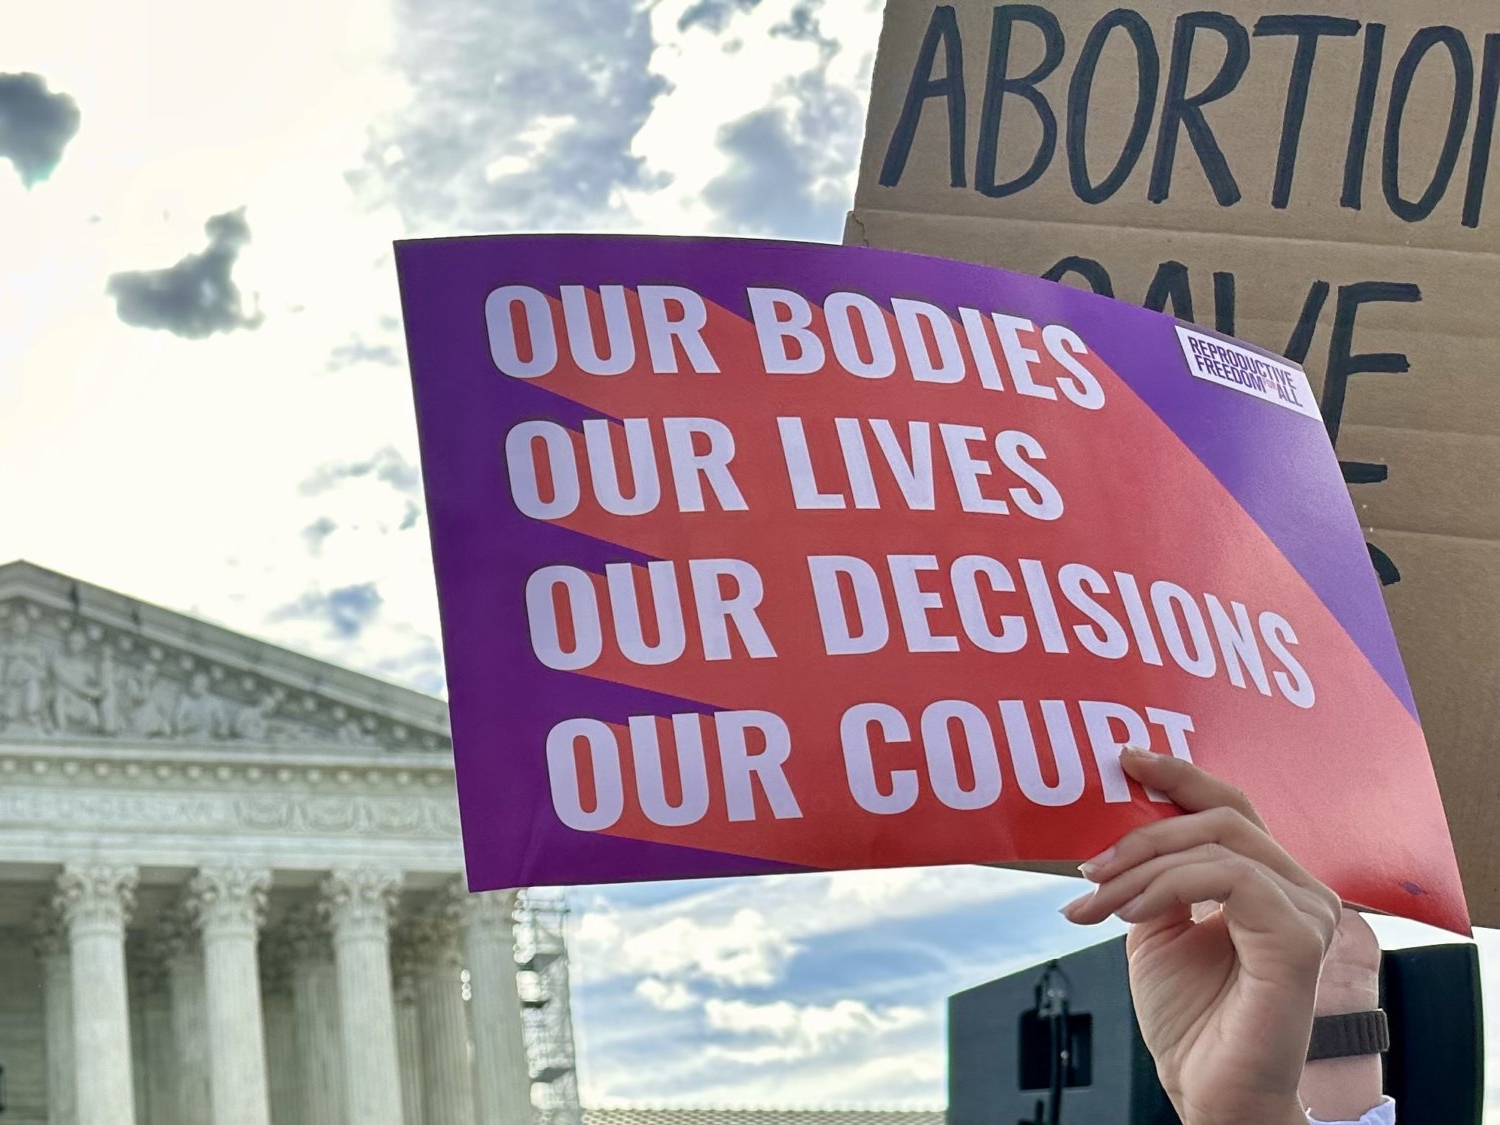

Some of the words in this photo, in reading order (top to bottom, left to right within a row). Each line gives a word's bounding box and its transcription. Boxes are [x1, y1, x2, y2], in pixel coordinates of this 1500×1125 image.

[484, 284, 721, 379] OUR
[746, 286, 1107, 411] BODIES
[1187, 335, 1296, 390] REPRODUCTIVE
[1194, 354, 1267, 394] FREEDOM
[1276, 383, 1304, 408] ALL
[505, 415, 750, 522] OUR
[775, 415, 1066, 522] LIVES
[524, 556, 778, 672] OUR
[806, 553, 1317, 709] DECISIONS
[545, 709, 804, 832] OUR
[838, 698, 1196, 816] COURT
